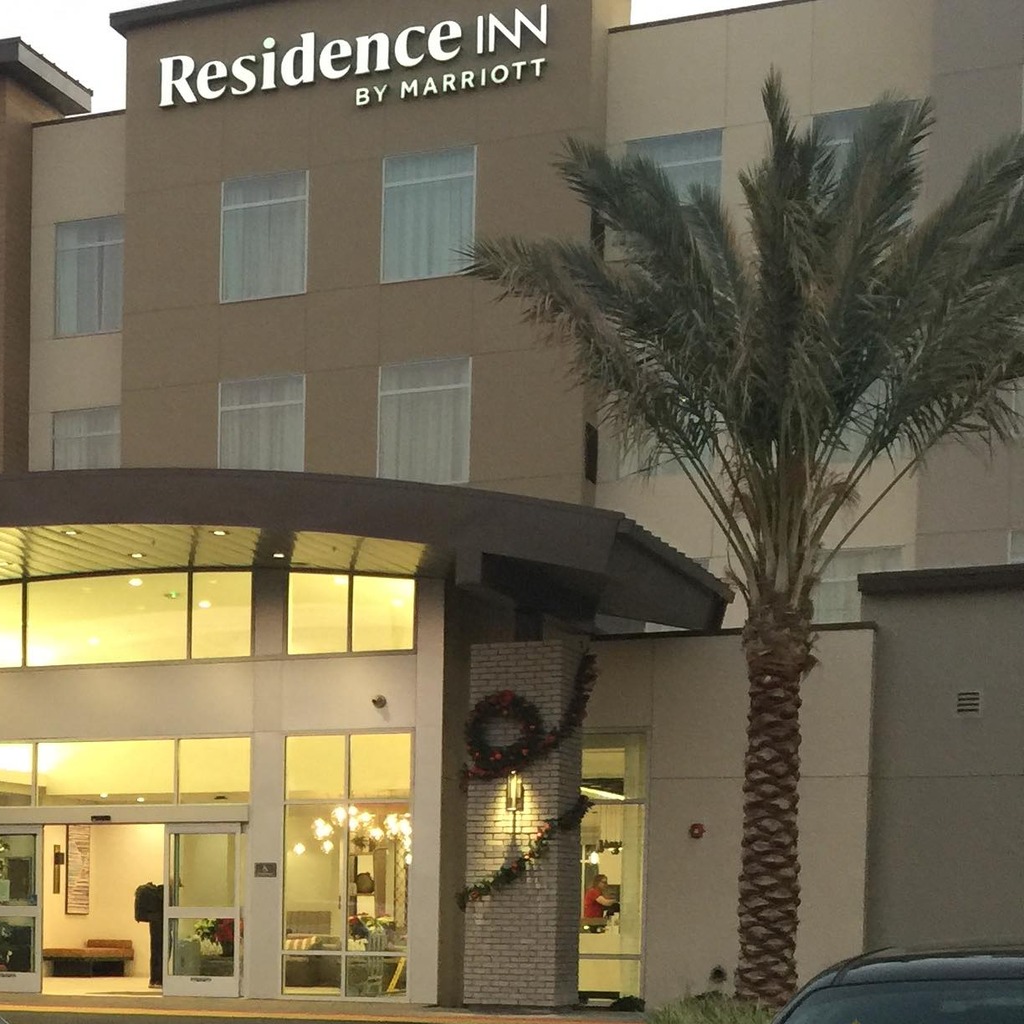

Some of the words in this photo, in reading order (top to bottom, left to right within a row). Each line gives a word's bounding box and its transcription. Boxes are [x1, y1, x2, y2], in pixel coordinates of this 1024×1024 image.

[158, 20, 462, 107] Residence
[477, 4, 548, 54] INN
[355, 84, 388, 106] BY
[400, 58, 546, 99] MARRIOTT
